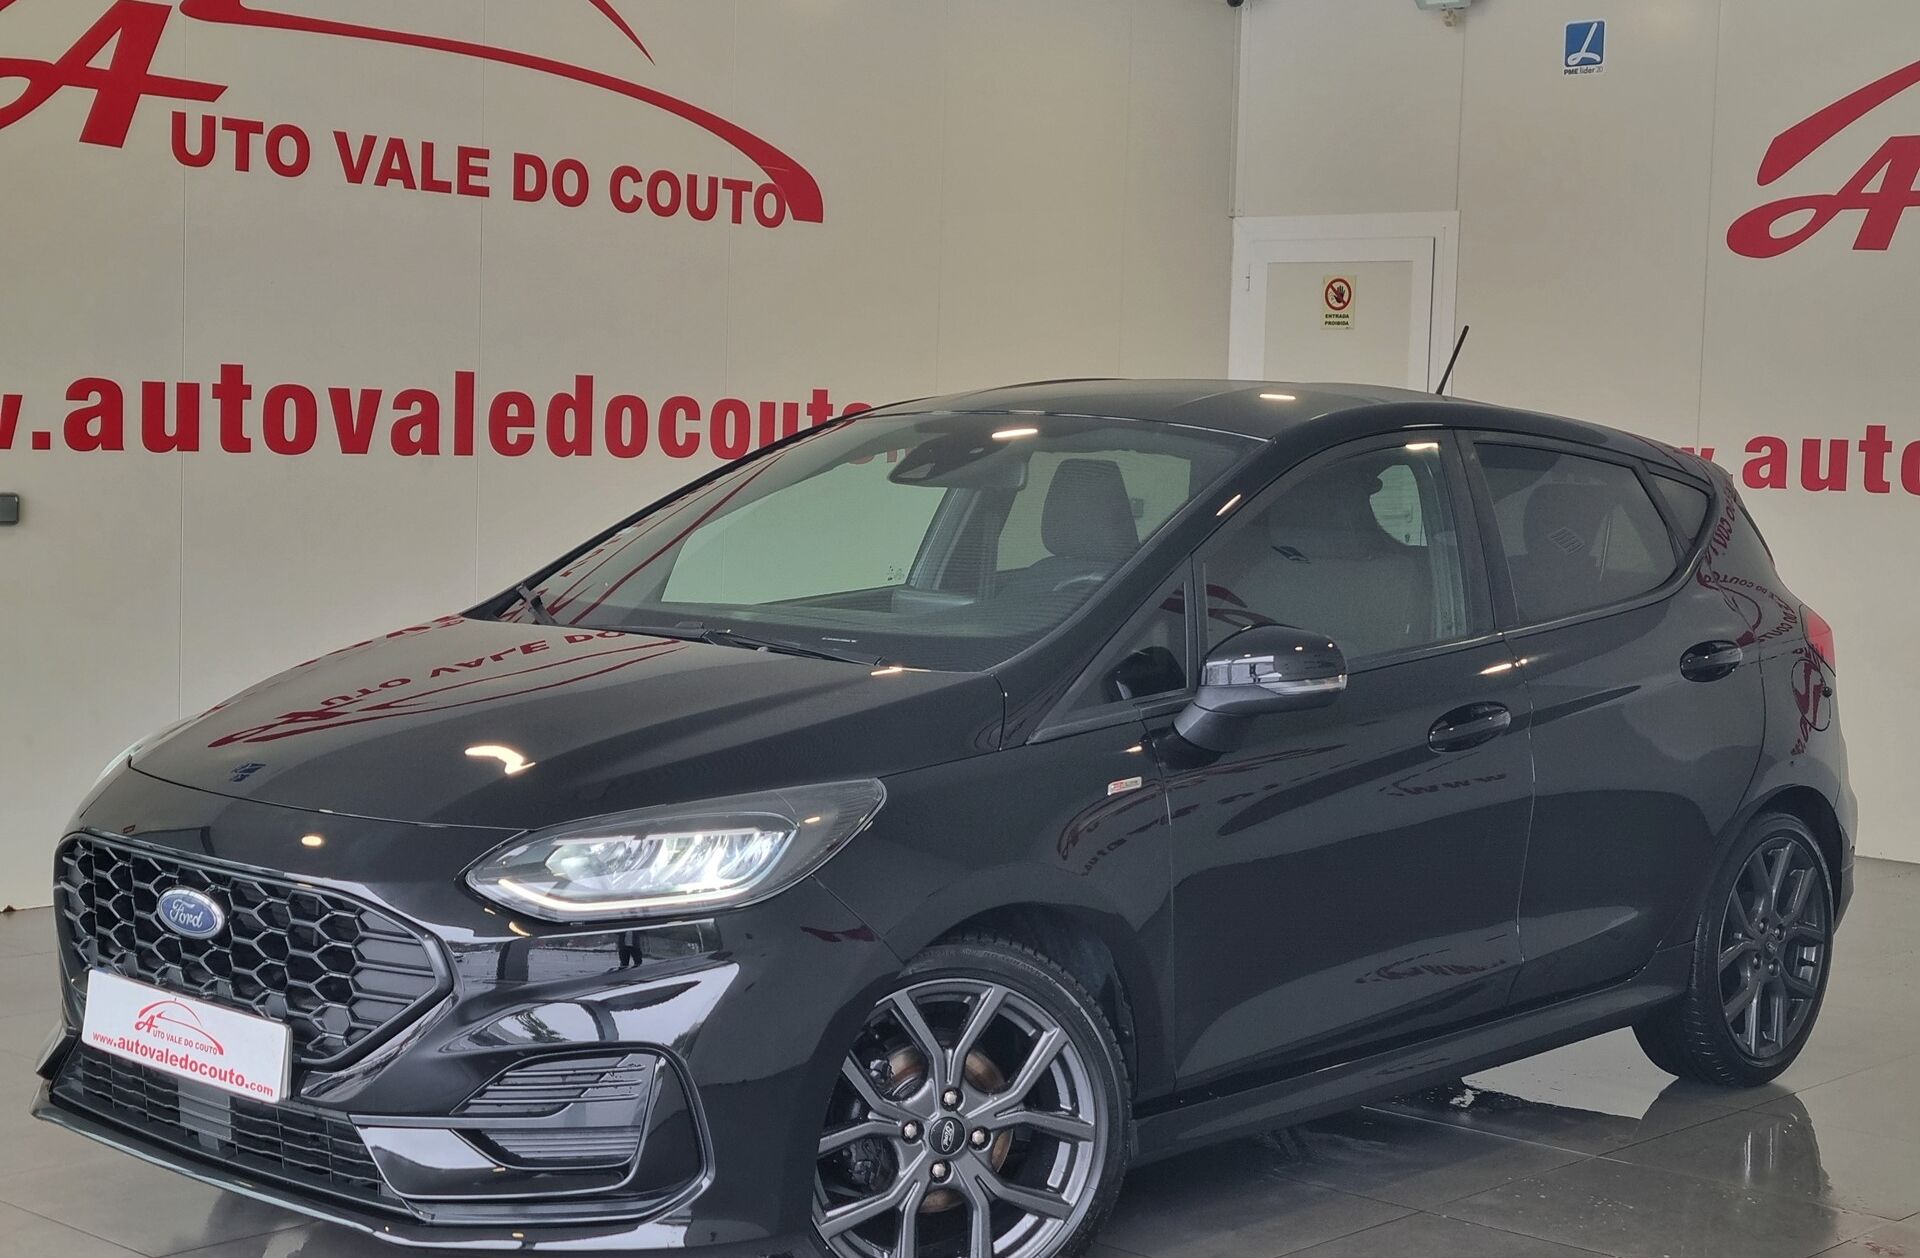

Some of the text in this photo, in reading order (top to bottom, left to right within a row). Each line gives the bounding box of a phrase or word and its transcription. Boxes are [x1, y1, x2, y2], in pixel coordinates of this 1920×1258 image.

[333, 131, 492, 198] VALE
[513, 153, 590, 207] DO
[609, 165, 787, 229] COUTO
[169, 899, 204, 928] Ford
[92, 1031, 274, 1097] www.autovaledocouto.com
[166, 1032, 183, 1045] VALE
[184, 1037, 194, 1048] DO
[195, 1041, 218, 1056] COUTO
